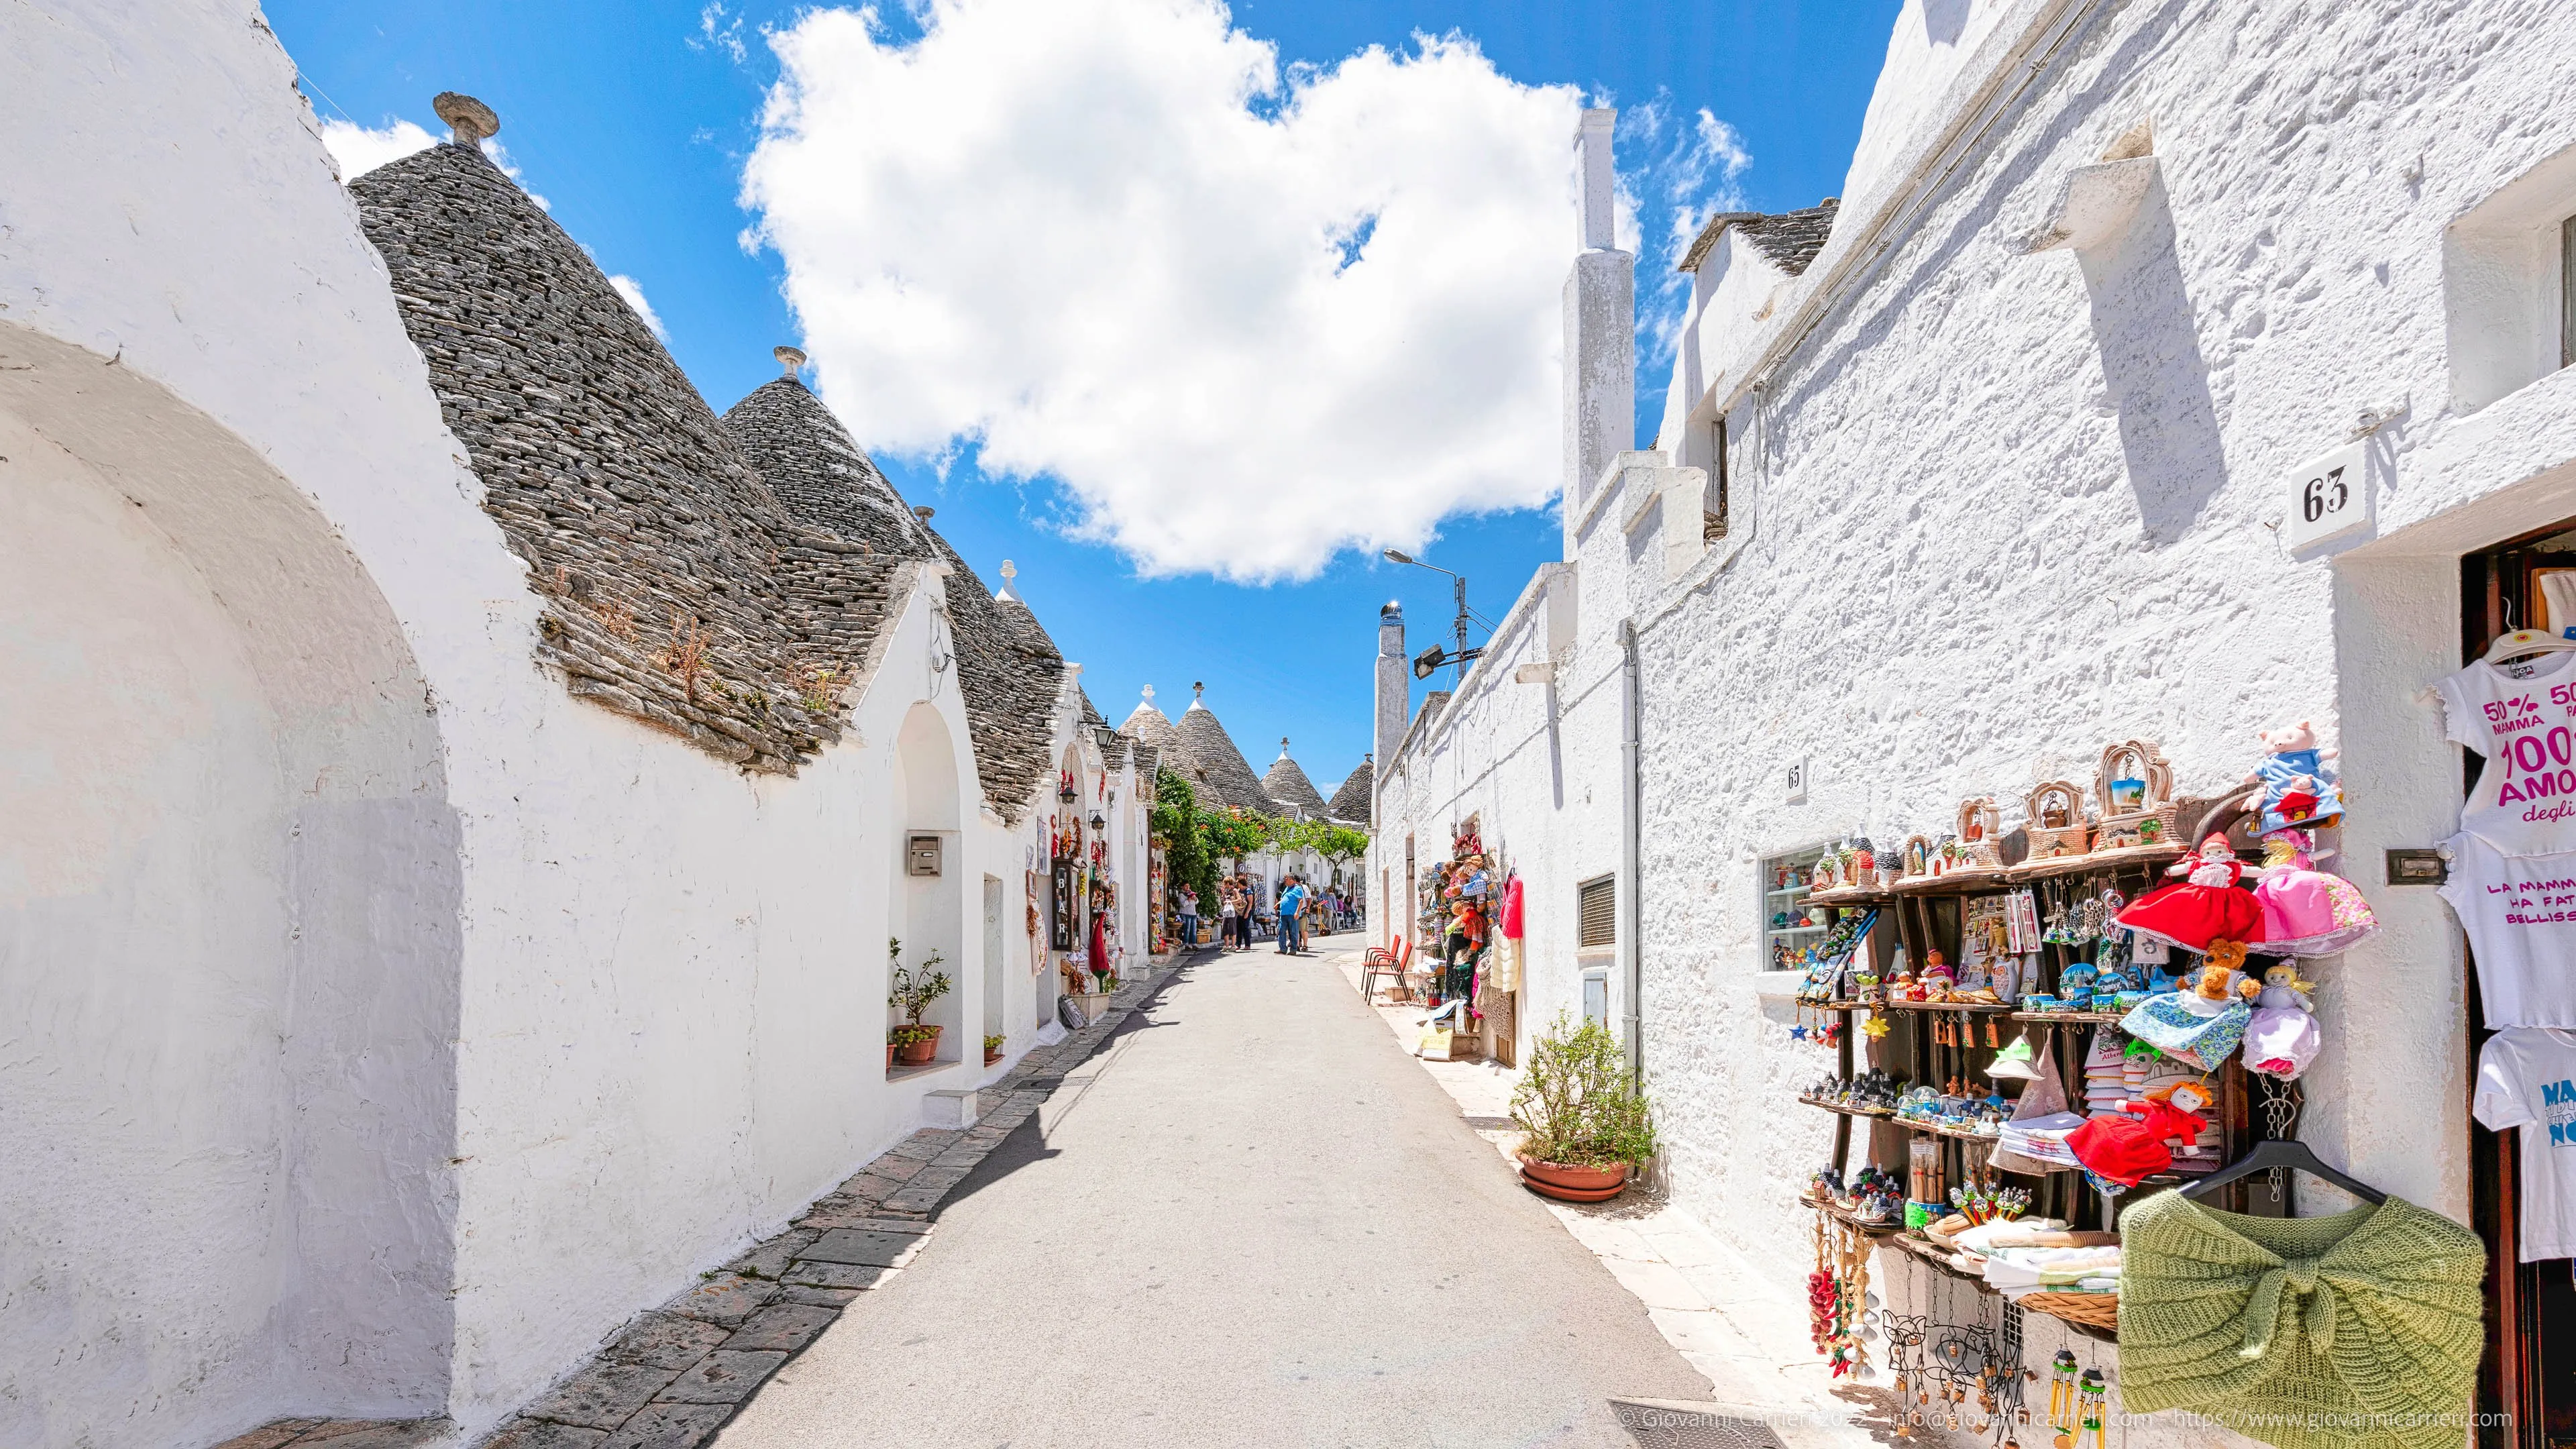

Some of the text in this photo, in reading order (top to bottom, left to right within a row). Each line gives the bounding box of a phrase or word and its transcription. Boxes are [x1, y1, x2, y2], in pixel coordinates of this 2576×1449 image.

[2304, 464, 2348, 523] 63
[2492, 715, 2544, 735] MAMMA
[2502, 726, 2576, 779] 100
[1788, 765, 1799, 789] 65
[2499, 769, 2576, 807] AMO
[2522, 800, 2575, 822] degli
[2487, 879, 2576, 894] LA MAMM
[1058, 878, 1066, 933] BAR
[2510, 894, 2576, 908] HA FAT
[2506, 911, 2576, 924] BELLISS
[2540, 1079, 2576, 1107] MA
